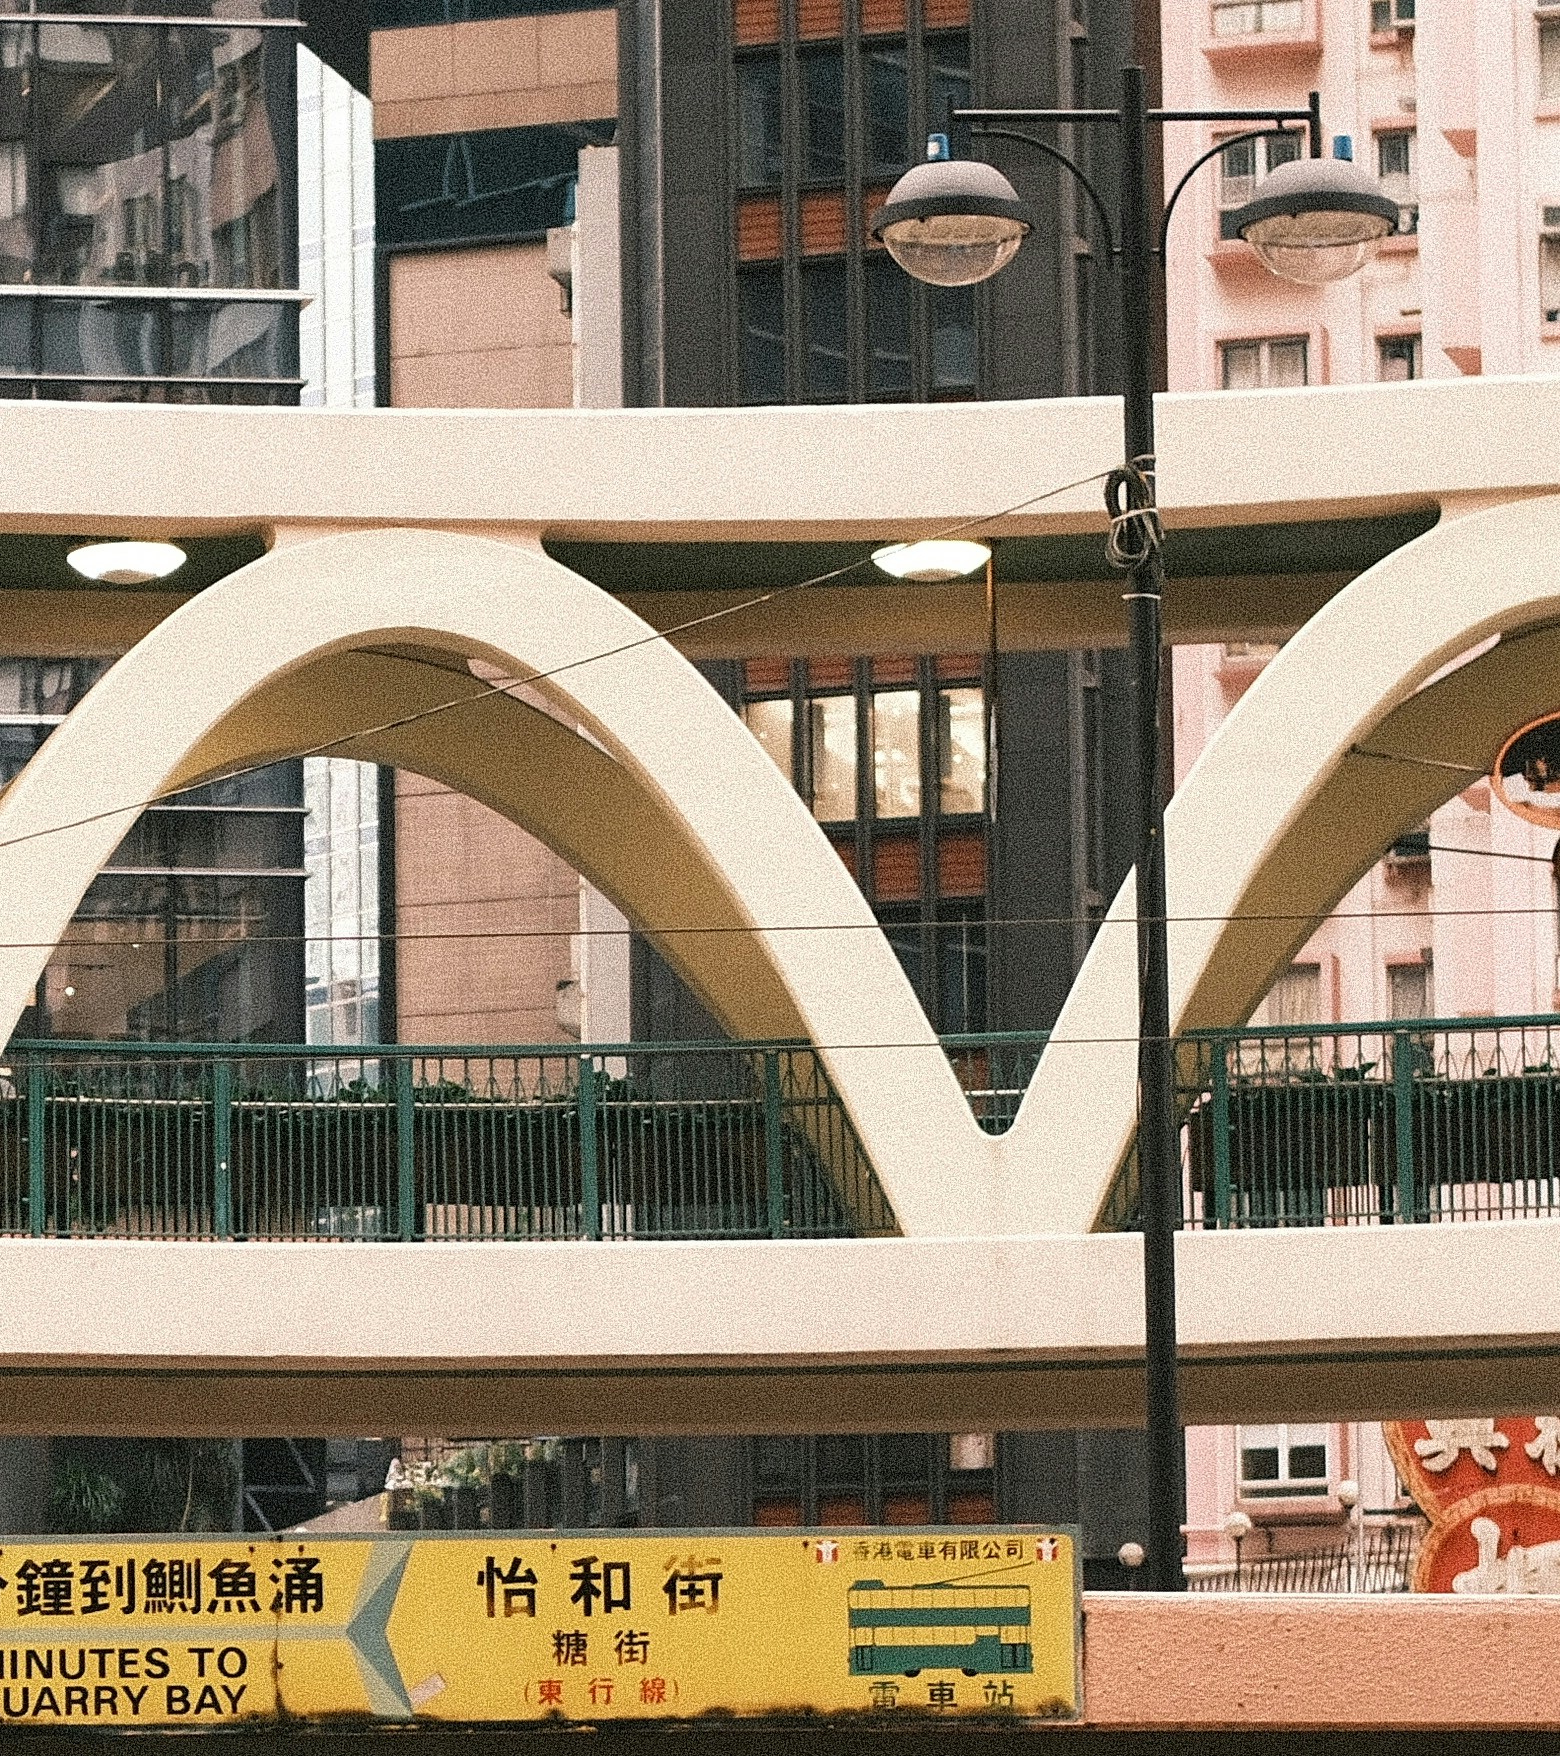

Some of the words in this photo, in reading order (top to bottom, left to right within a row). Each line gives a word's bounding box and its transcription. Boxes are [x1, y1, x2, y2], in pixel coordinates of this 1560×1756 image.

[853, 1539, 1024, 1561] 香港電車有限公司
[477, 1554, 723, 1618] 怡和街
[187, 1647, 247, 1679] TO
[552, 1629, 649, 1666] 糖街
[166, 1683, 248, 1716] BAY
[869, 1680, 1015, 1709] 電車站
